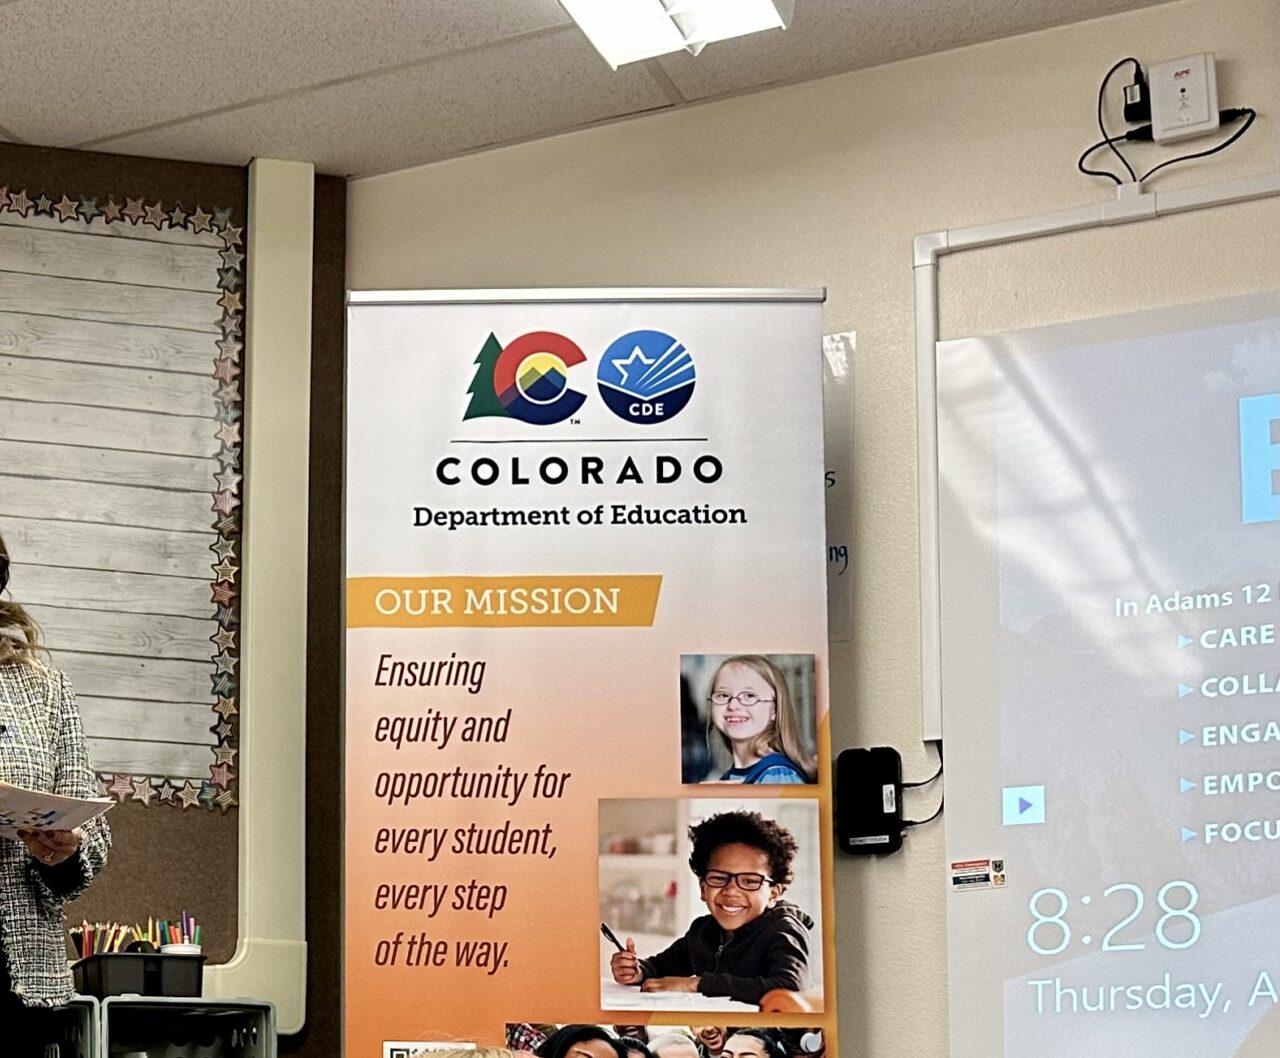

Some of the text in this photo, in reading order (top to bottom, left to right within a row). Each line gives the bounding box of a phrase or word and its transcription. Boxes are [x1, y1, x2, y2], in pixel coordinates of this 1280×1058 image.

[629, 403, 664, 416] CDE
[436, 455, 723, 486] COLORADO
[413, 503, 747, 530] Department of Education
[374, 587, 620, 616] OUR MISSION
[1115, 583, 1272, 617] In Adams 12
[1200, 623, 1275, 649] CARE
[374, 653, 487, 694] Ensuring
[1201, 672, 1280, 698] COLL
[374, 708, 512, 750] equity and
[374, 764, 571, 804] opportunity for
[374, 821, 557, 861] every student,
[374, 880, 507, 919] every step
[1027, 880, 1201, 955] 8:28
[374, 932, 509, 975] of the way.
[1027, 973, 1232, 1018] Thursday,
